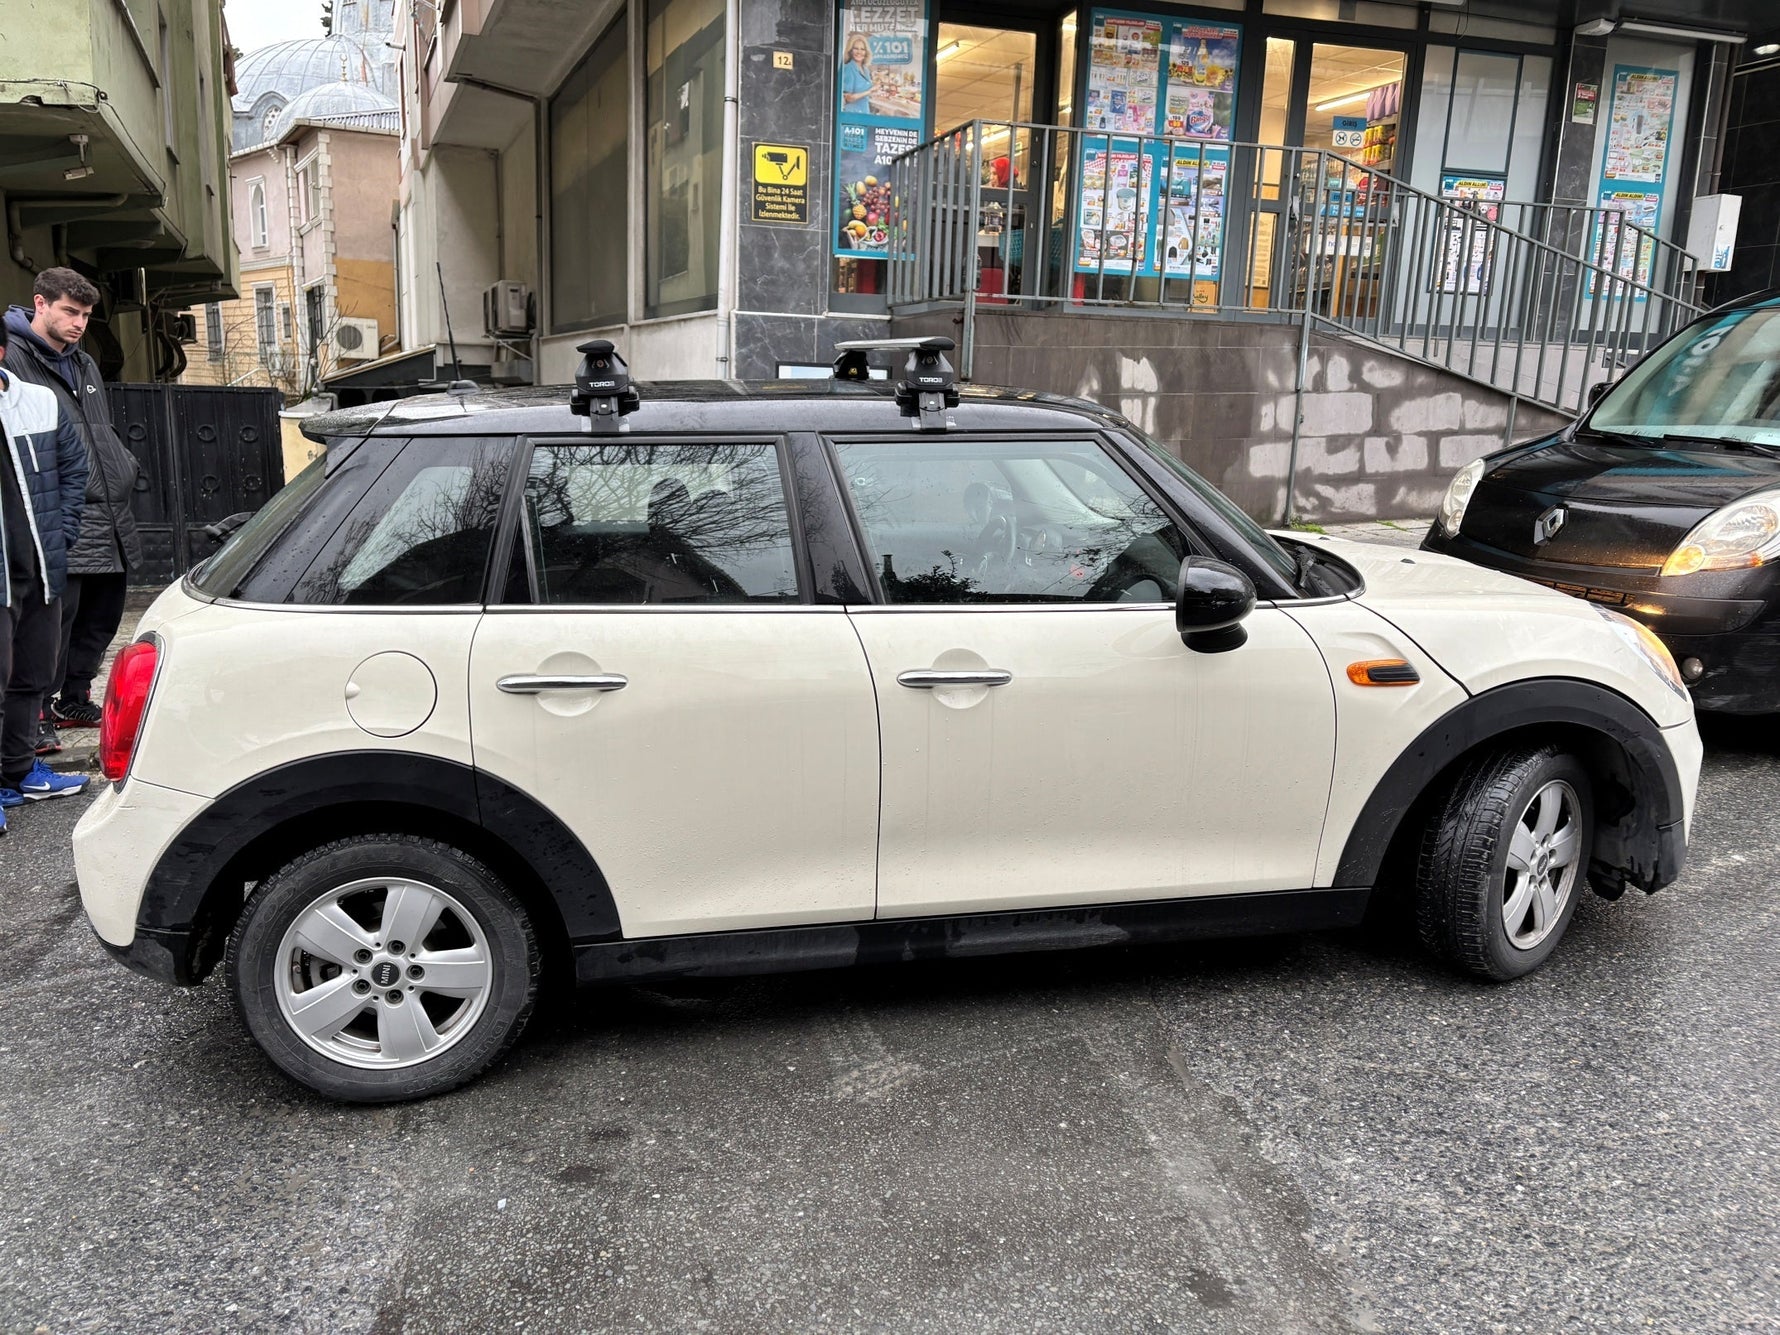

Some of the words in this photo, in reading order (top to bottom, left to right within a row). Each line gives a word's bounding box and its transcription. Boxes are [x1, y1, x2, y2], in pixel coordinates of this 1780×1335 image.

[849, 5, 919, 22] LEZZET
[790, 188, 803, 196] Saat
[756, 194, 782, 202] Güvenlik
[782, 195, 805, 204] Kamera
[765, 202, 787, 210] Sistemi
[380, 964, 392, 984] MINI
